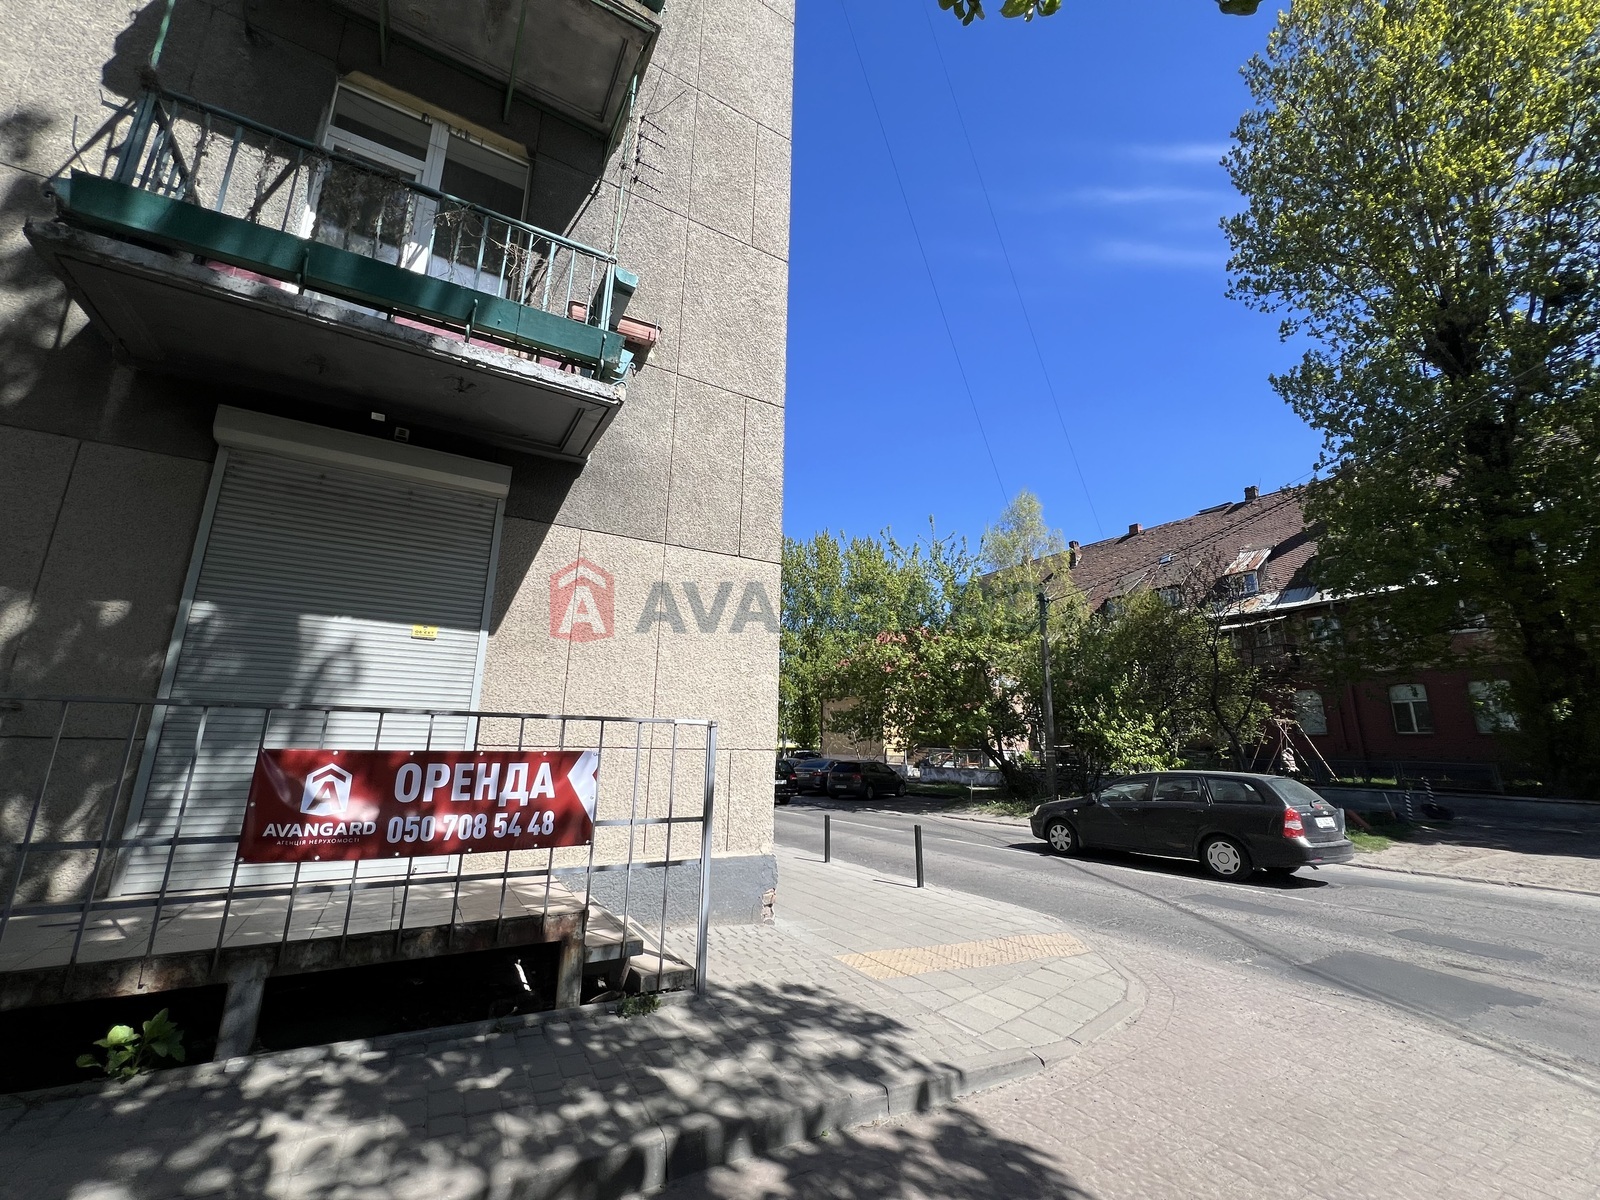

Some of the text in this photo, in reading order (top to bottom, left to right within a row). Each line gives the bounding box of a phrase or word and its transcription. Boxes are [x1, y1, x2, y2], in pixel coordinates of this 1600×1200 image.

[394, 762, 555, 807] ОРЕНДА
[262, 821, 377, 838] AVANGARD
[386, 810, 555, 843] 050 708 54 48
